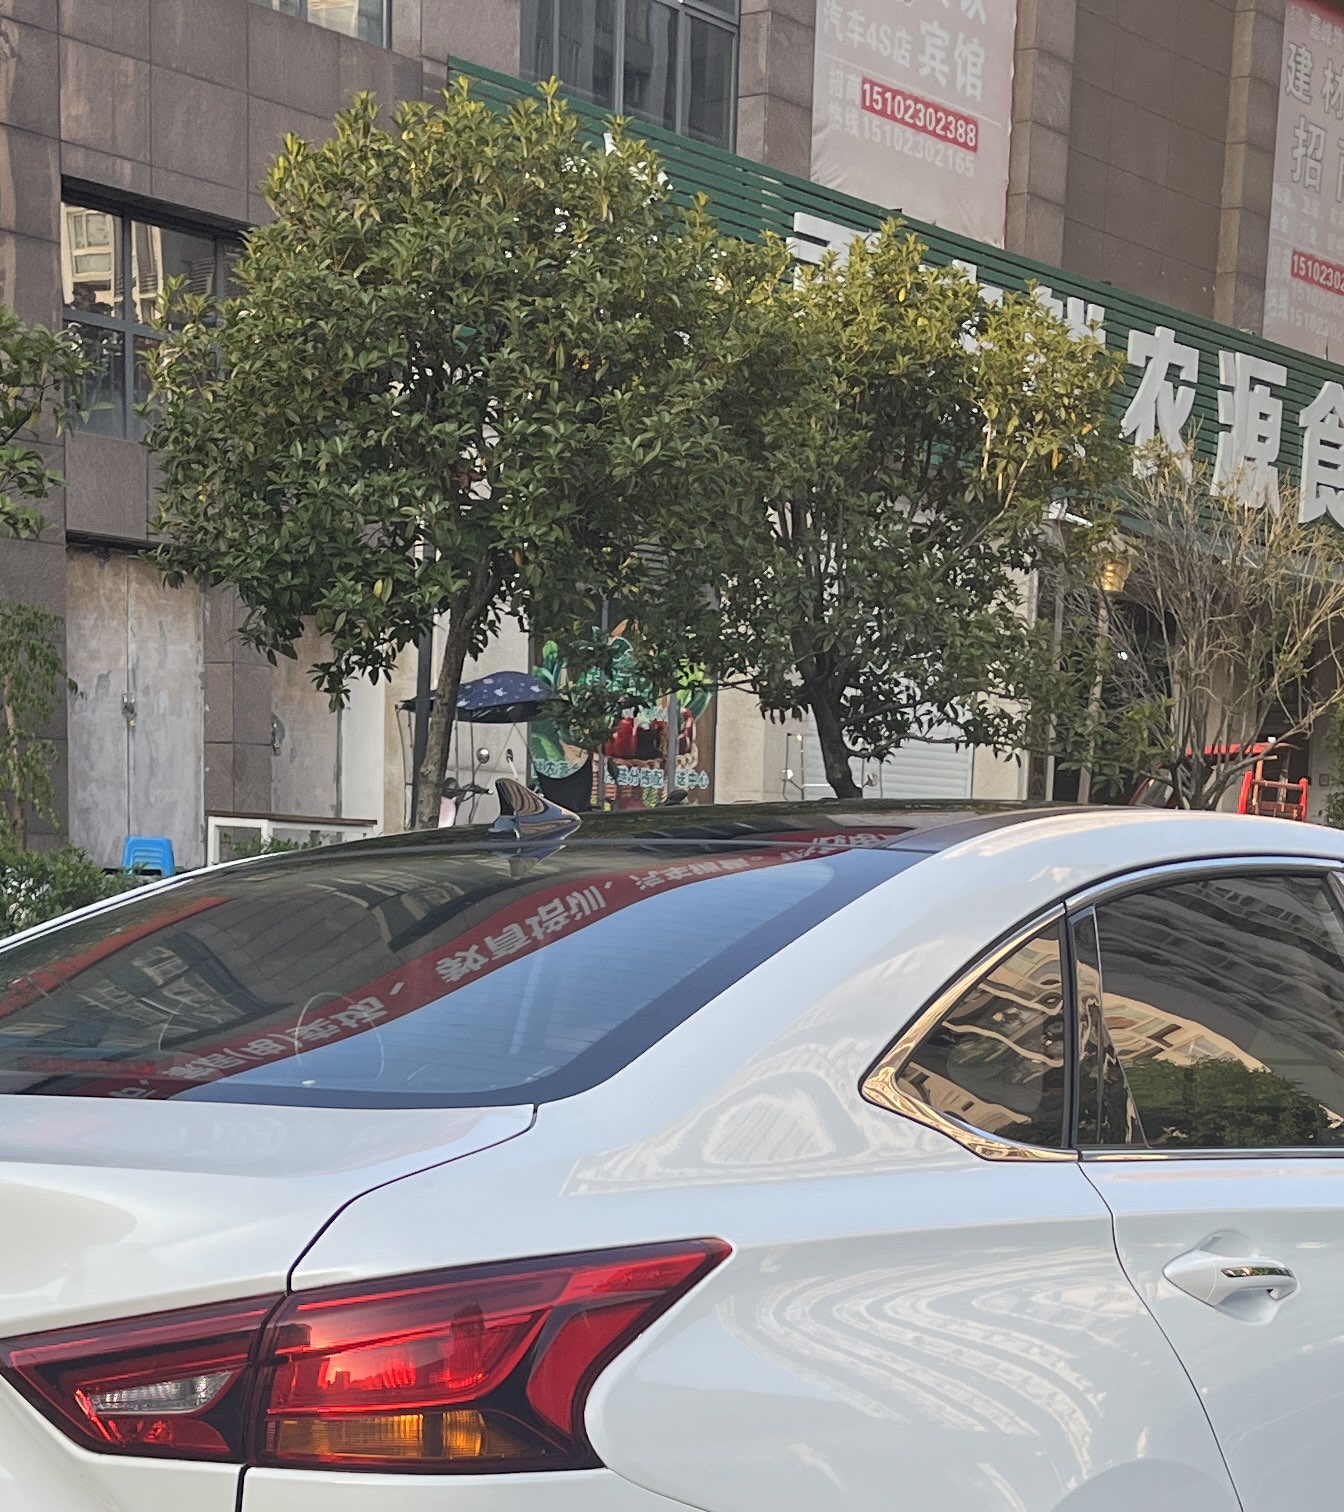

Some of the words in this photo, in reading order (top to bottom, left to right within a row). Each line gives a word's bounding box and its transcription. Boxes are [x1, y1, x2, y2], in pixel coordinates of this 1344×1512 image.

[918, 19, 986, 101] 宾馆
[863, 83, 977, 147] 15102302388
[864, 116, 975, 178] 15102302165
